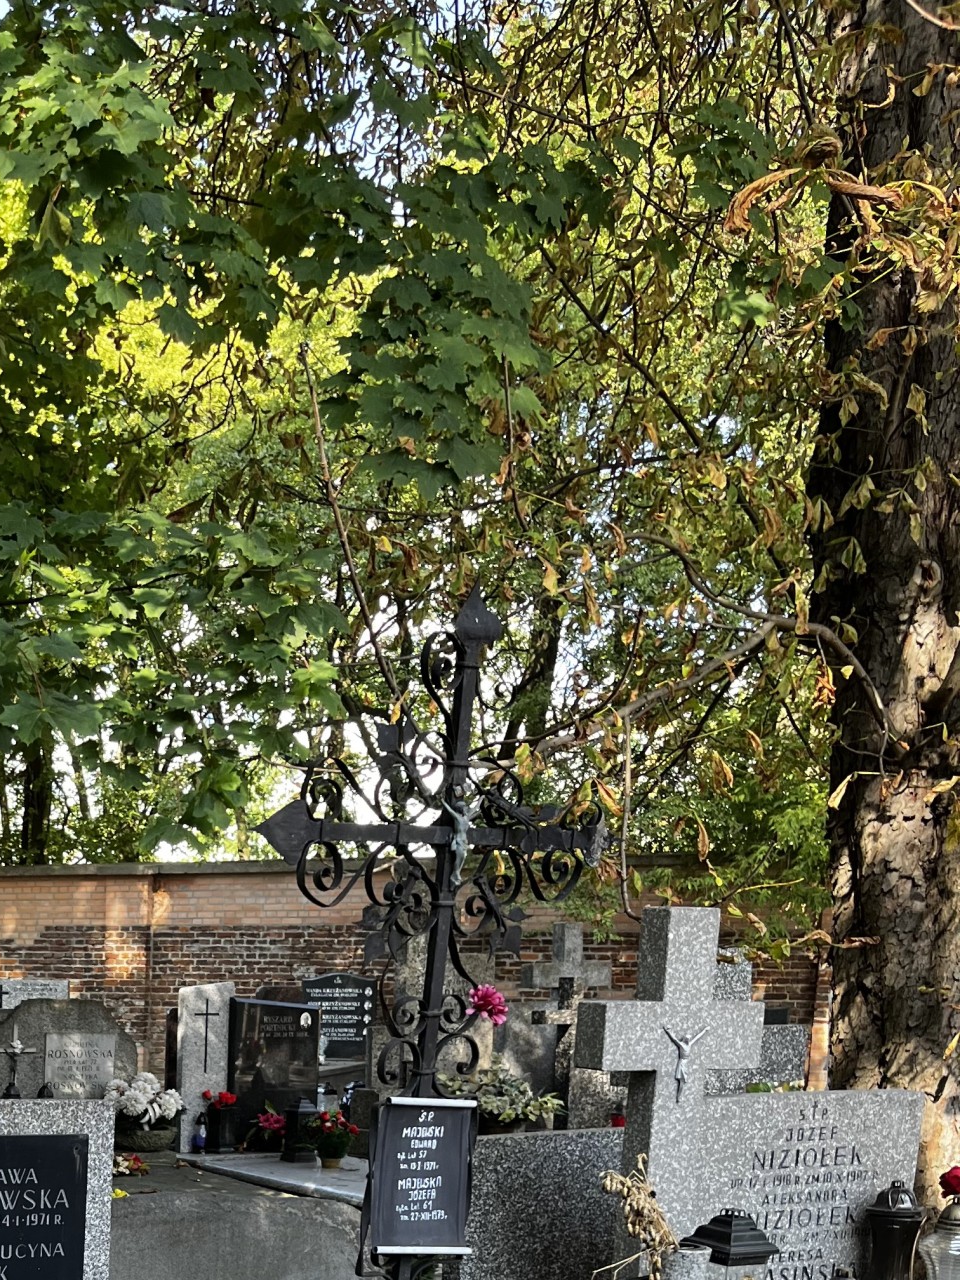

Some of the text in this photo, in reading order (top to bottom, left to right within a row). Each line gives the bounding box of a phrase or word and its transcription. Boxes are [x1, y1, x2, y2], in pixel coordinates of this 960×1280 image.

[402, 1126, 445, 1139] MAJEWSKI
[410, 1139, 438, 1150] EDWARD
[752, 1146, 862, 1171] NIZIOŁEK
[397, 1176, 443, 1190] MAJEWSKA
[408, 1189, 437, 1201] JÓZEFA
[54, 1213, 66, 1226] R.
